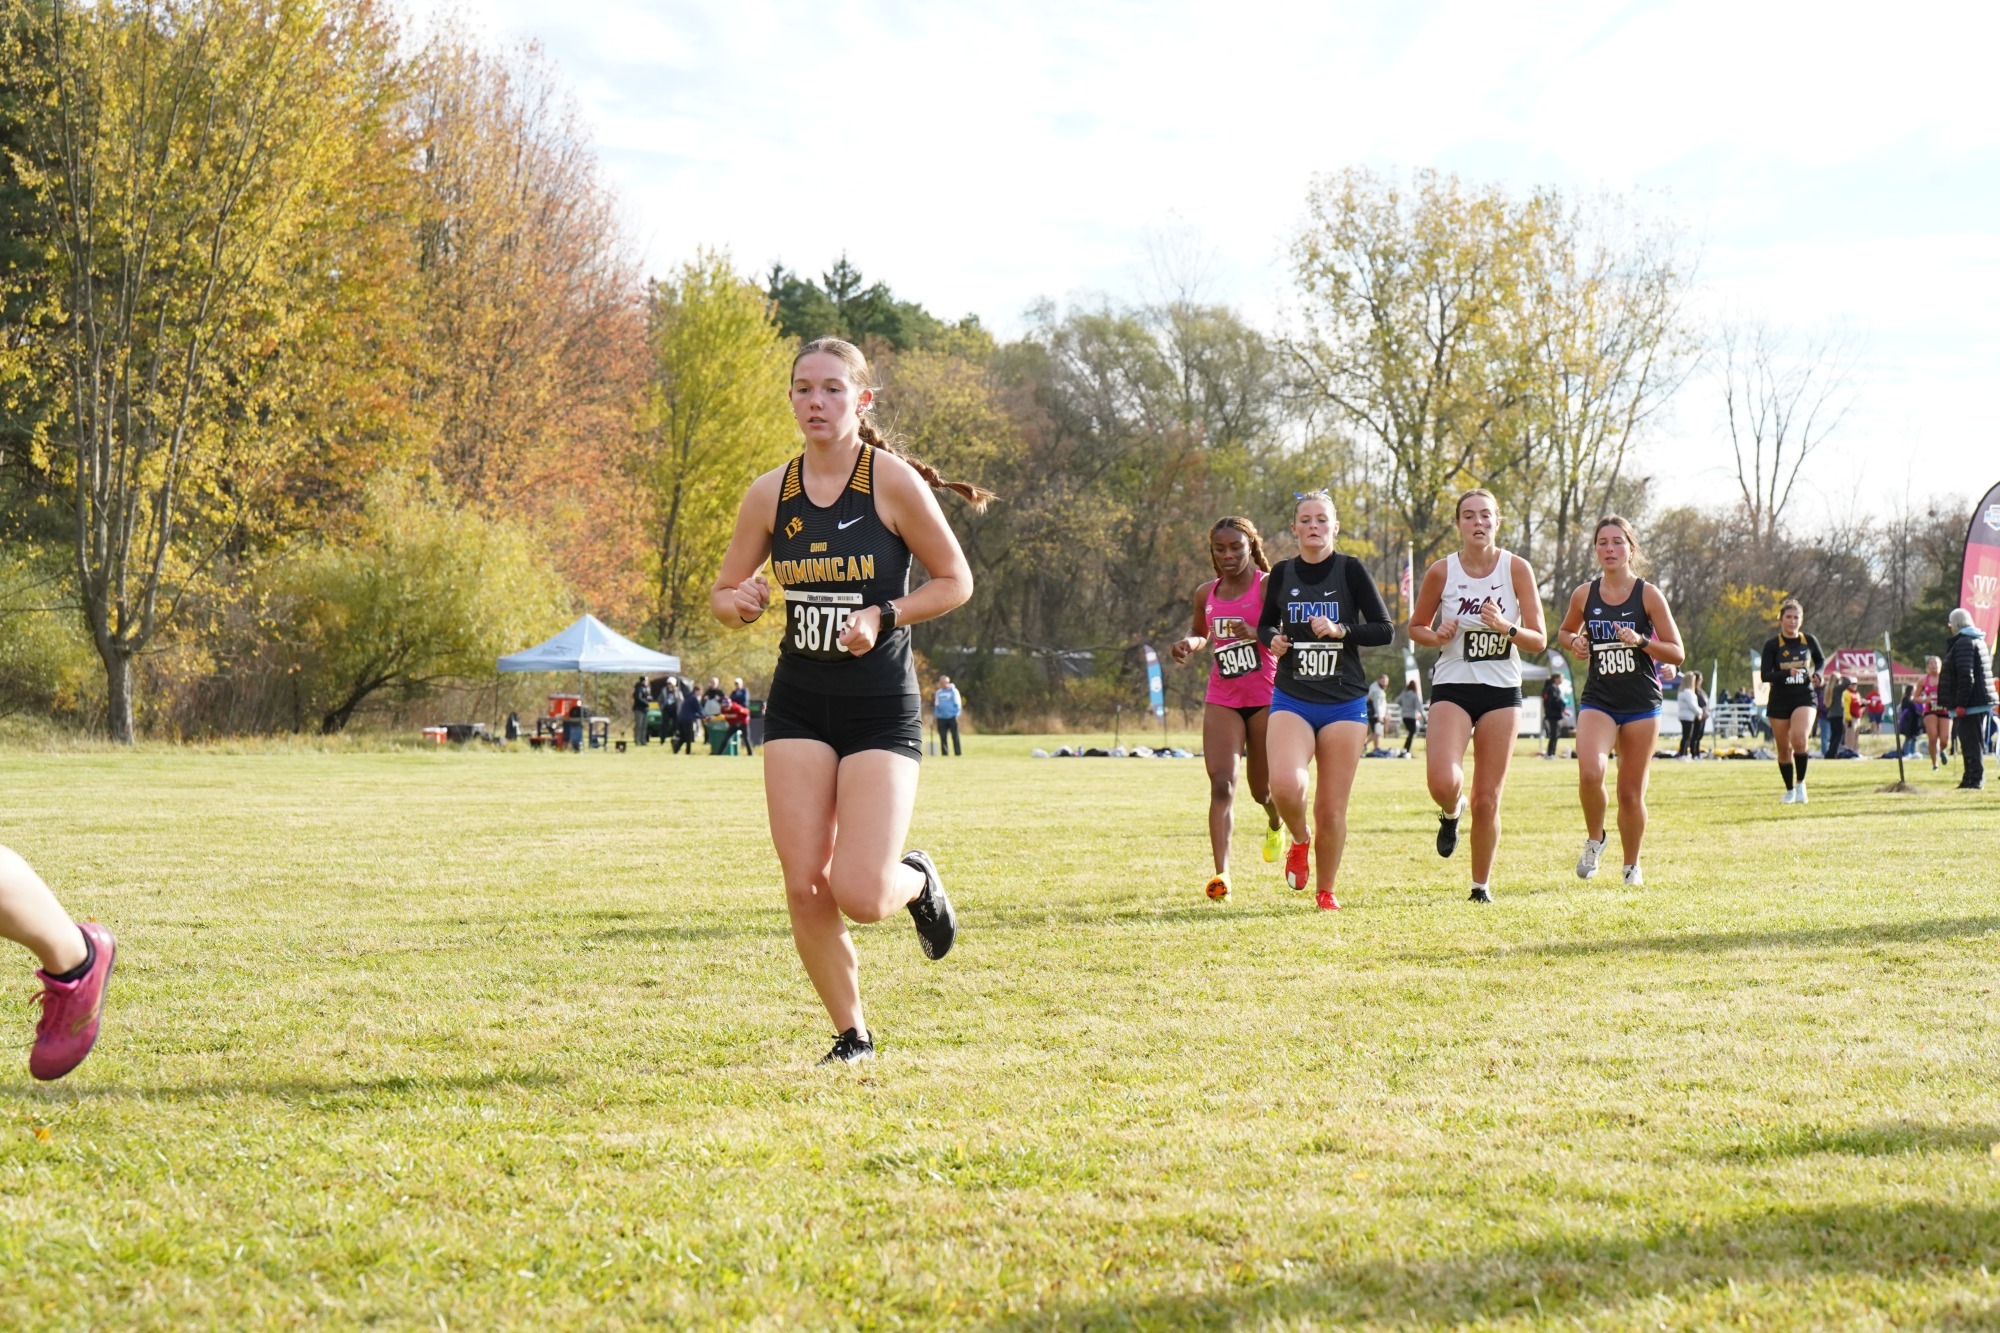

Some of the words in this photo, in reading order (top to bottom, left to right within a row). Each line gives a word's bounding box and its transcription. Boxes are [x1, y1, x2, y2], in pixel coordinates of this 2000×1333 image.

[810, 542, 827, 553] OHIO
[774, 554, 875, 586] DOMINICAN
[1287, 602, 1339, 623] TMU
[1457, 596, 1505, 615] Walh
[794, 604, 851, 653] 3875
[1468, 632, 1508, 658] 3969
[1219, 645, 1257, 675] 3940
[1298, 650, 1338, 676] 3907
[1598, 648, 1636, 675] 3896
